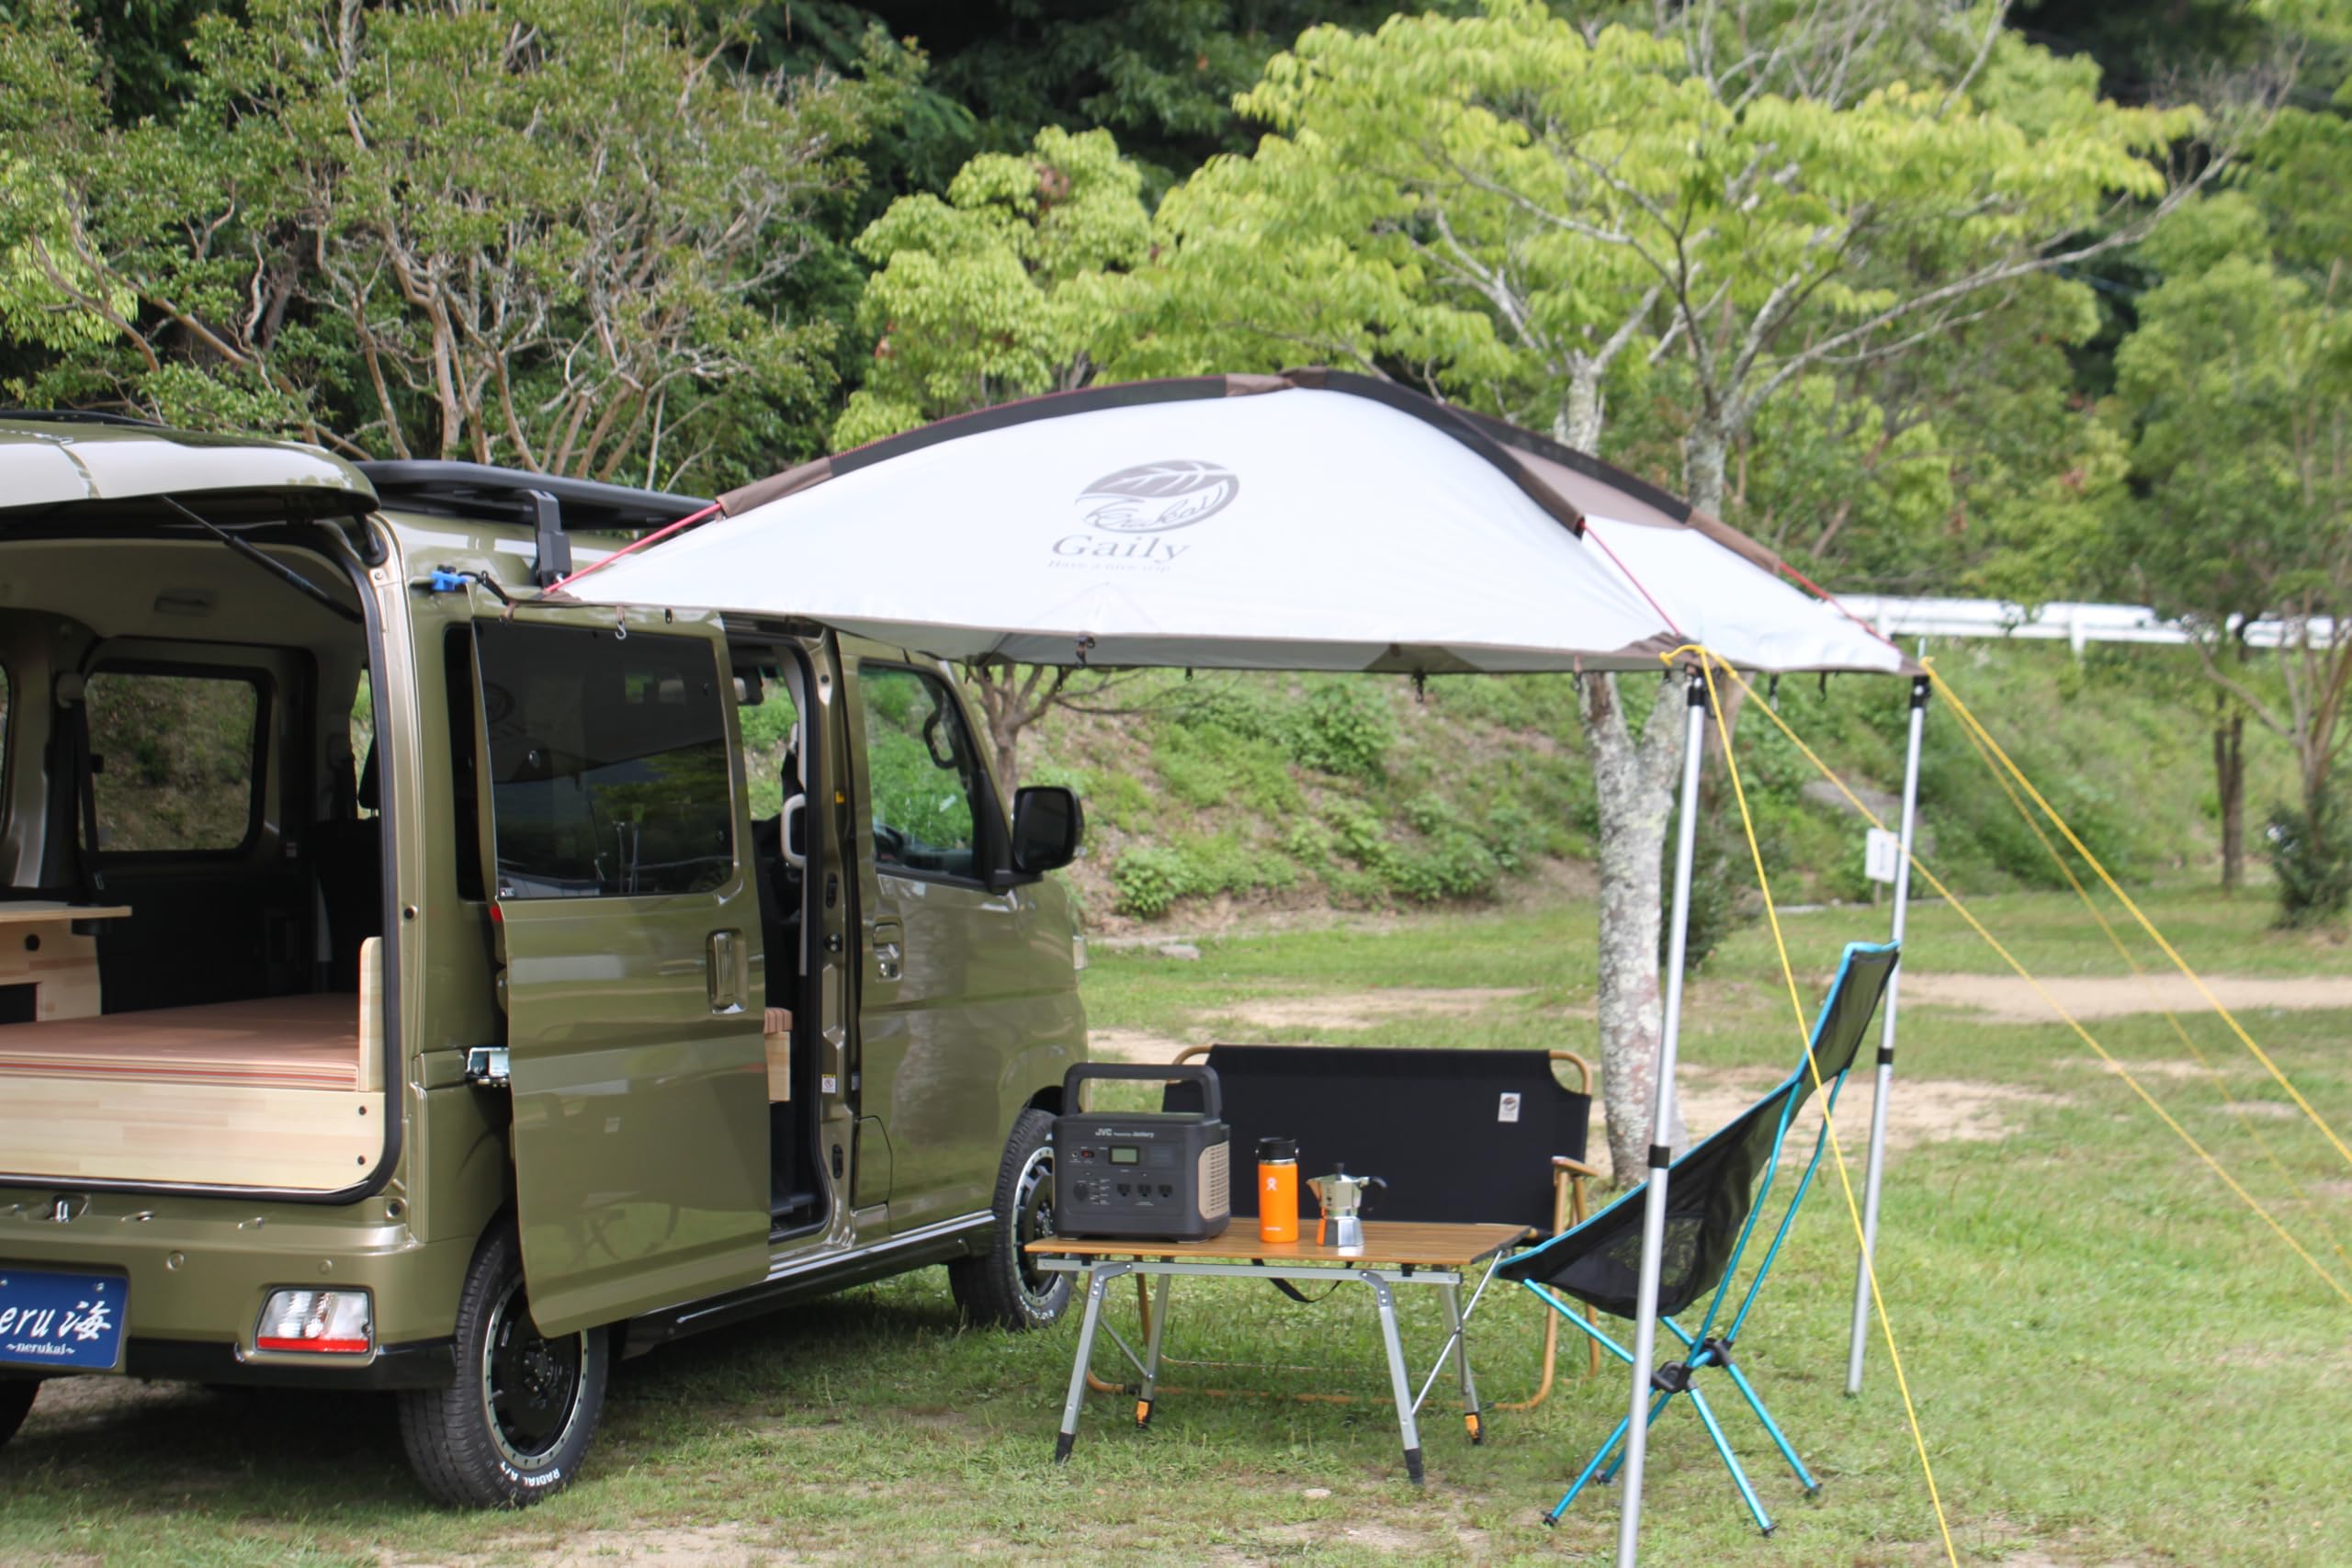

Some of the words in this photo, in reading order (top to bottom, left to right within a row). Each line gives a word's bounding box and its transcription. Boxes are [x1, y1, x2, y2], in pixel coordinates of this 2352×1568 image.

[1052, 535, 1192, 564] Gaily
[1095, 1128, 1113, 1136] JVC
[522, 1467, 560, 1487] RADIAL
